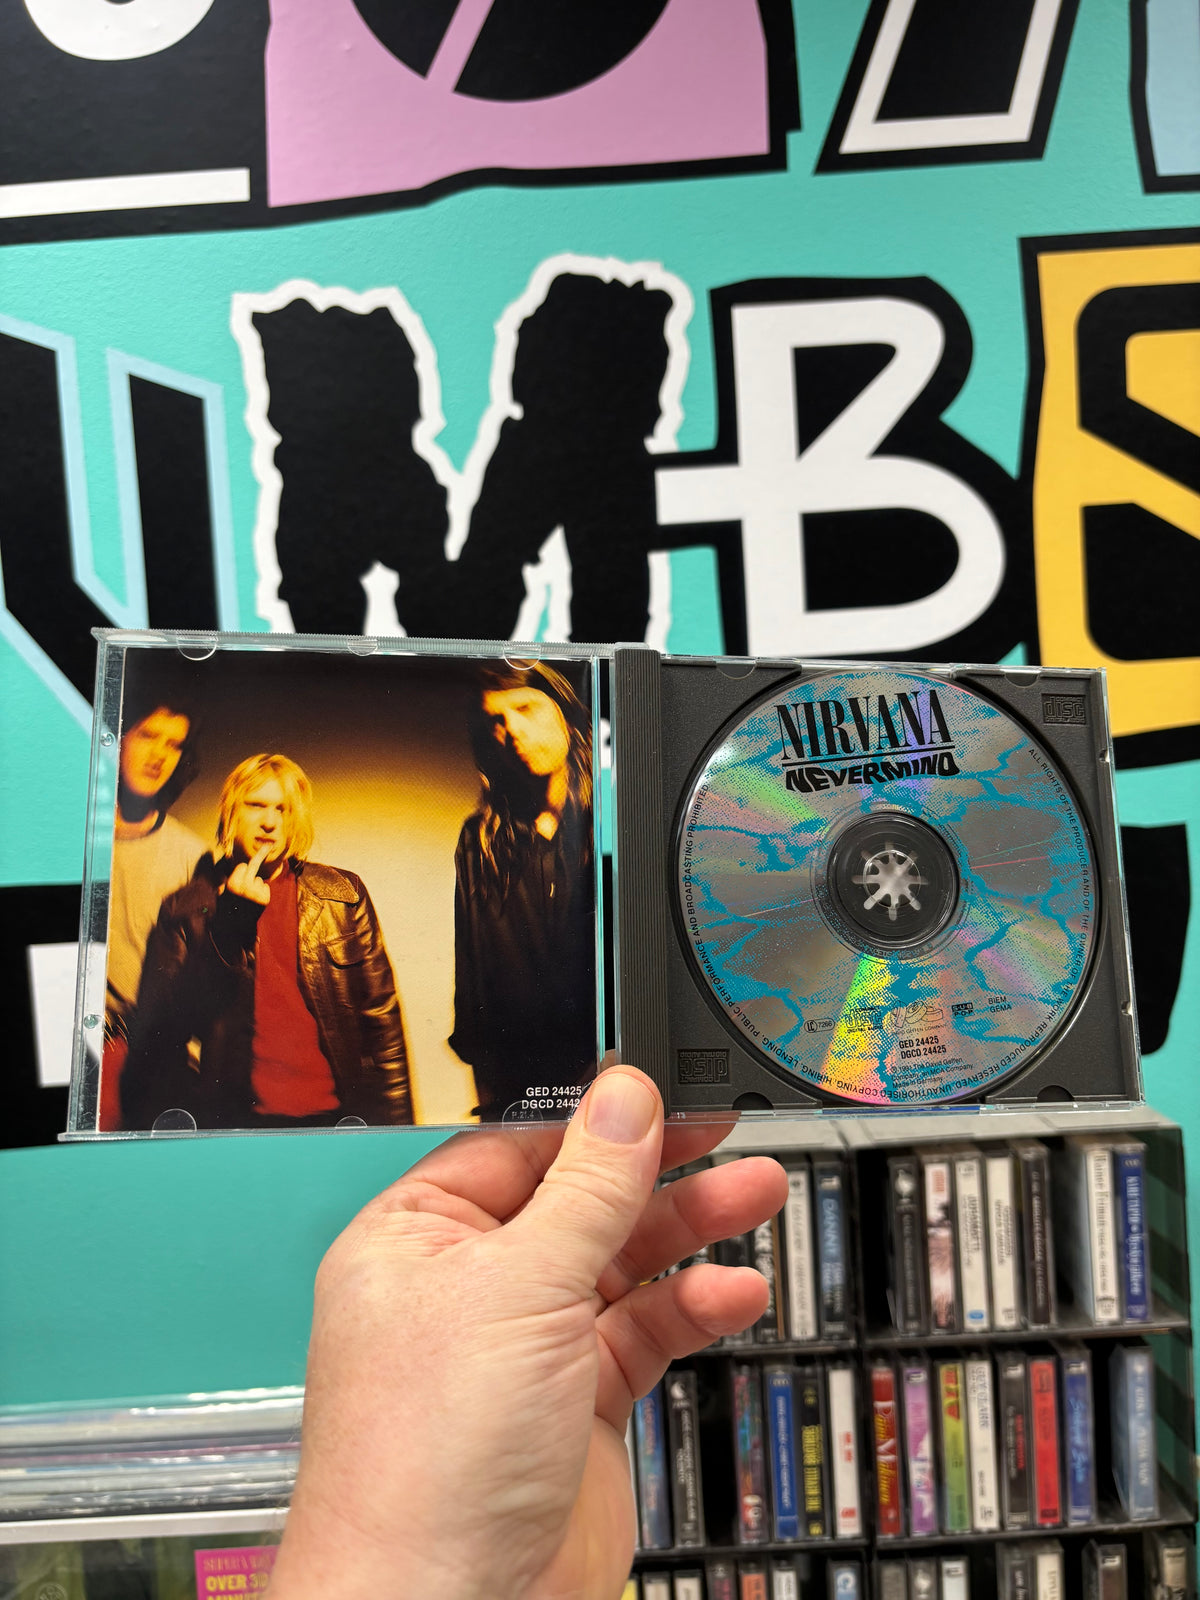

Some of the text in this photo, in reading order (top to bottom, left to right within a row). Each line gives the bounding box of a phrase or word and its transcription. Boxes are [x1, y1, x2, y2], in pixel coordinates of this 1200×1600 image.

[774, 689, 954, 760] NIRVANA
[1028, 748, 1043, 764] ALL
[786, 751, 960, 793] NEVERMIND
[1040, 762, 1063, 794] RIGHTS
[1058, 793, 1069, 807] OF
[1064, 805, 1077, 824] THE
[1072, 825, 1089, 876] PRODUCER
[685, 839, 695, 915] BROADCASTING
[690, 916, 701, 937] AND
[696, 938, 735, 1008] PERFORMANCE
[1045, 997, 1065, 1022] WORK
[732, 1006, 760, 1037] PUBLIC
[899, 1036, 939, 1049] GED 24425
[901, 1045, 947, 1059] DGCD 24425
[999, 1021, 1048, 1067] REPRODUCED
[526, 1085, 582, 1097] GED 24425
[521, 1099, 580, 1109] DGCD 2442
[206, 1575, 247, 1592] OVER
